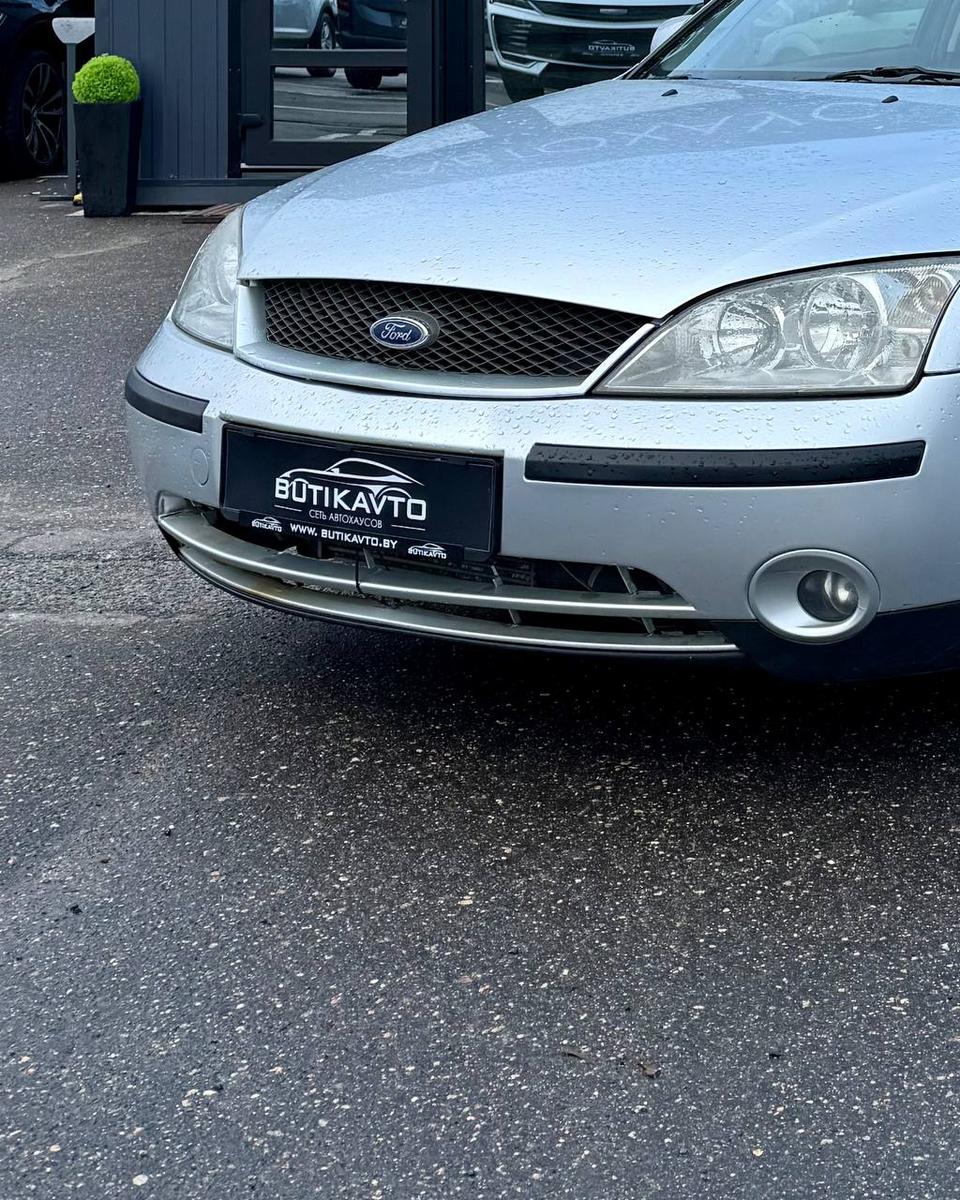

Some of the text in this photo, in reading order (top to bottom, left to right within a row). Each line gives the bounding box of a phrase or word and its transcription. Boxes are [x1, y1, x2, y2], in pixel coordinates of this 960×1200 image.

[380, 322, 413, 341] Ford
[274, 477, 427, 521] BUTIKAVTO
[251, 520, 283, 532] BUTIKAVTO
[309, 509, 383, 529] СЕТЬ АВТОХАУСОВ
[289, 522, 398, 549] WWW. BUTIKAVTO.BY
[407, 547, 447, 559] BUTIKAVTO
